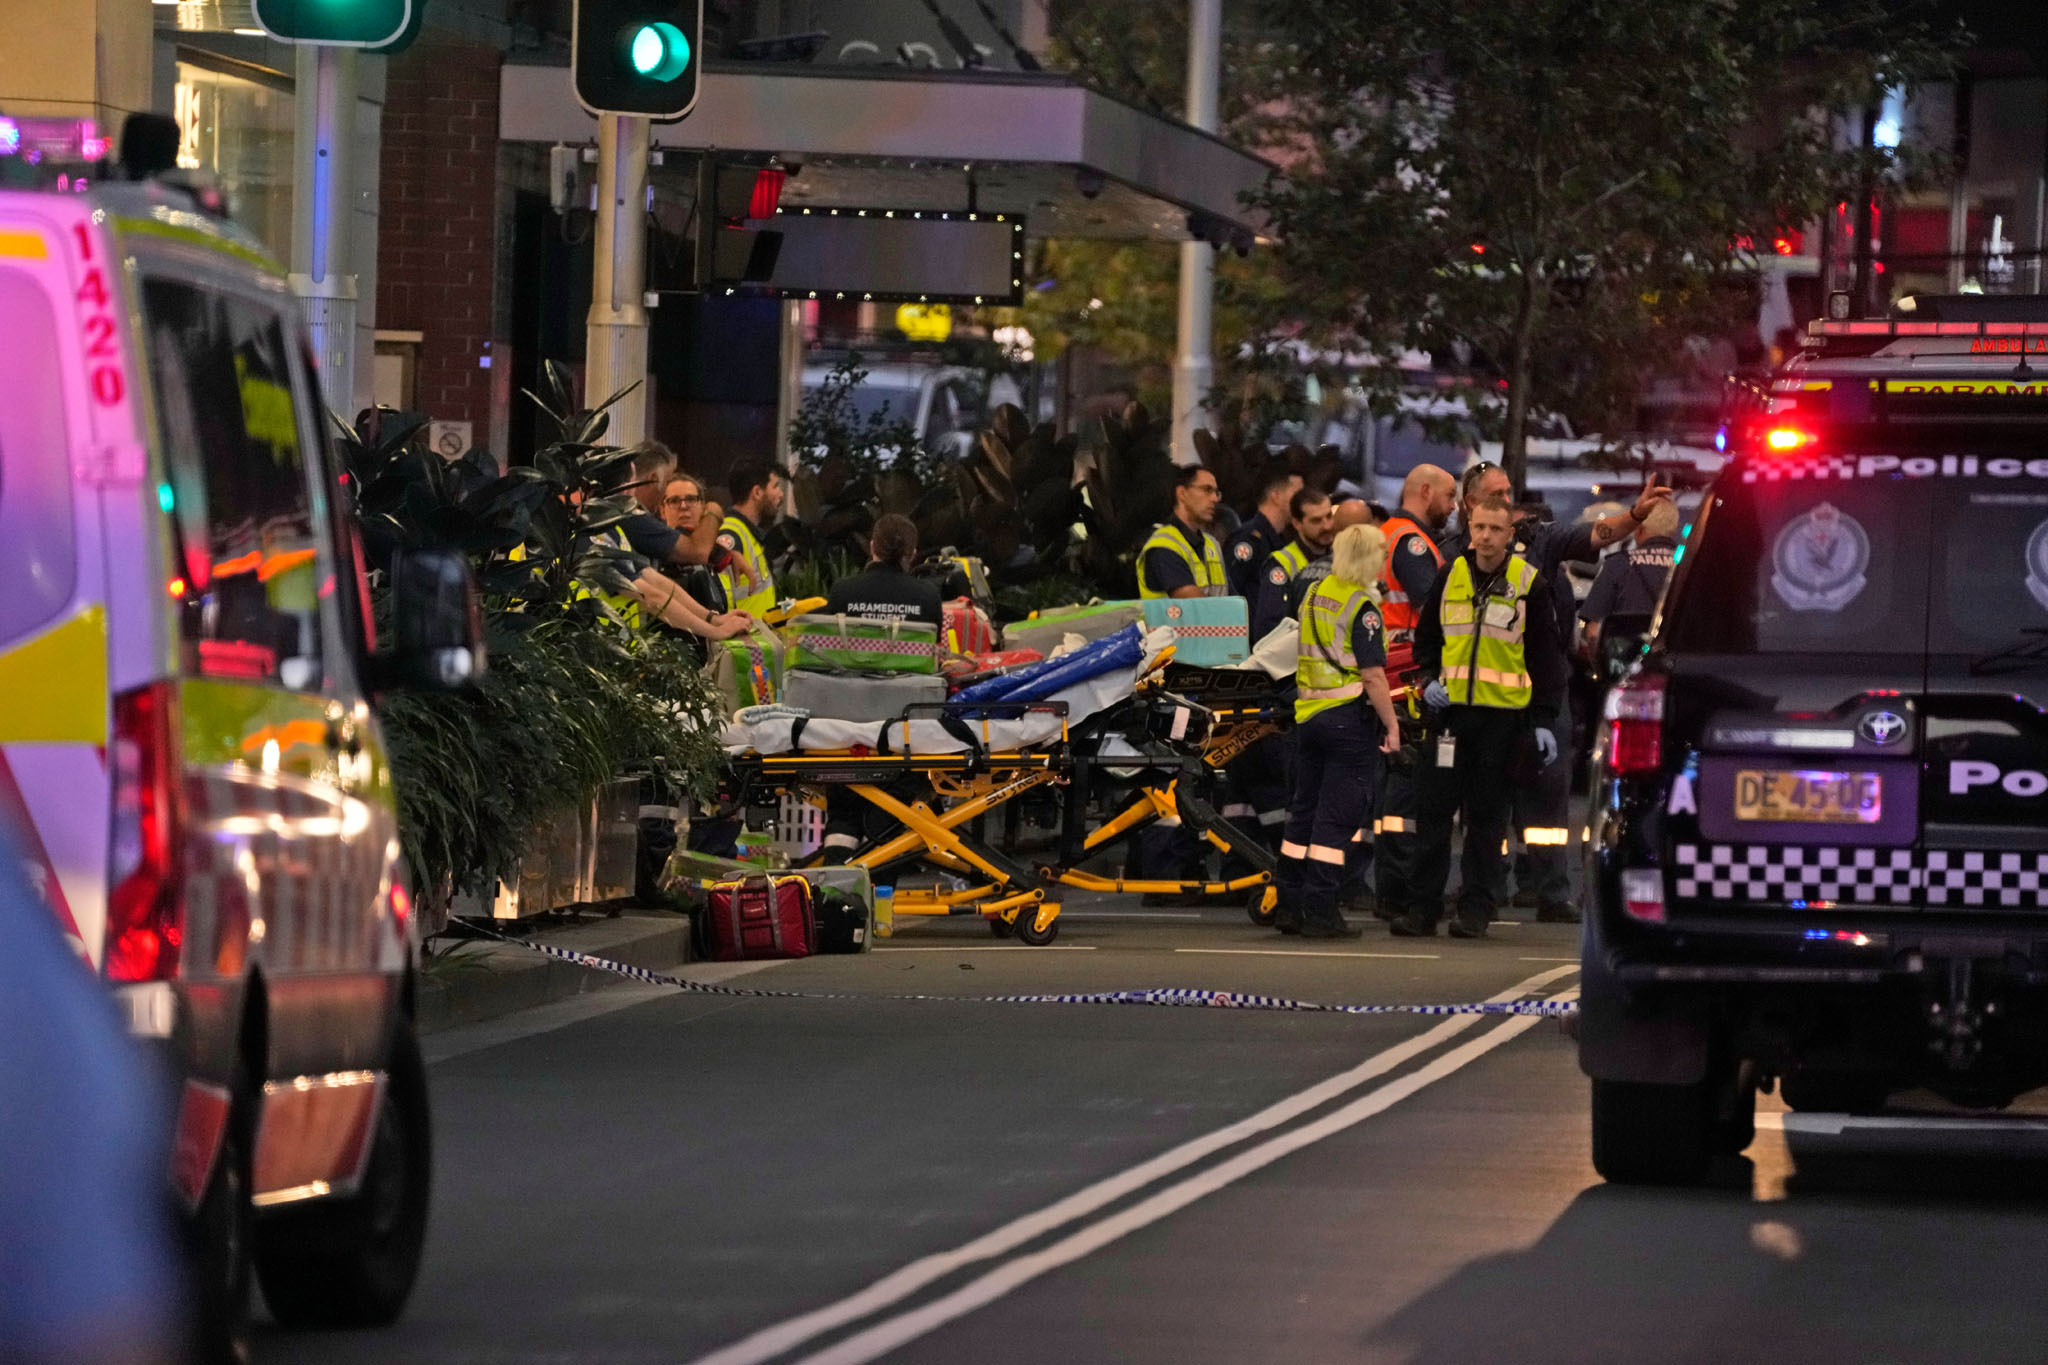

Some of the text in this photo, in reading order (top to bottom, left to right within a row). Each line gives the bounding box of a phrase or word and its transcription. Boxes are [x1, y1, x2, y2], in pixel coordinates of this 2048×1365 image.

[74, 223, 125, 408] 1420
[1970, 337, 2048, 353] AMBULA
[847, 603, 920, 615] PARAMEDICINE
[1211, 726, 1260, 765] stryker
[1949, 760, 2048, 796] Po
